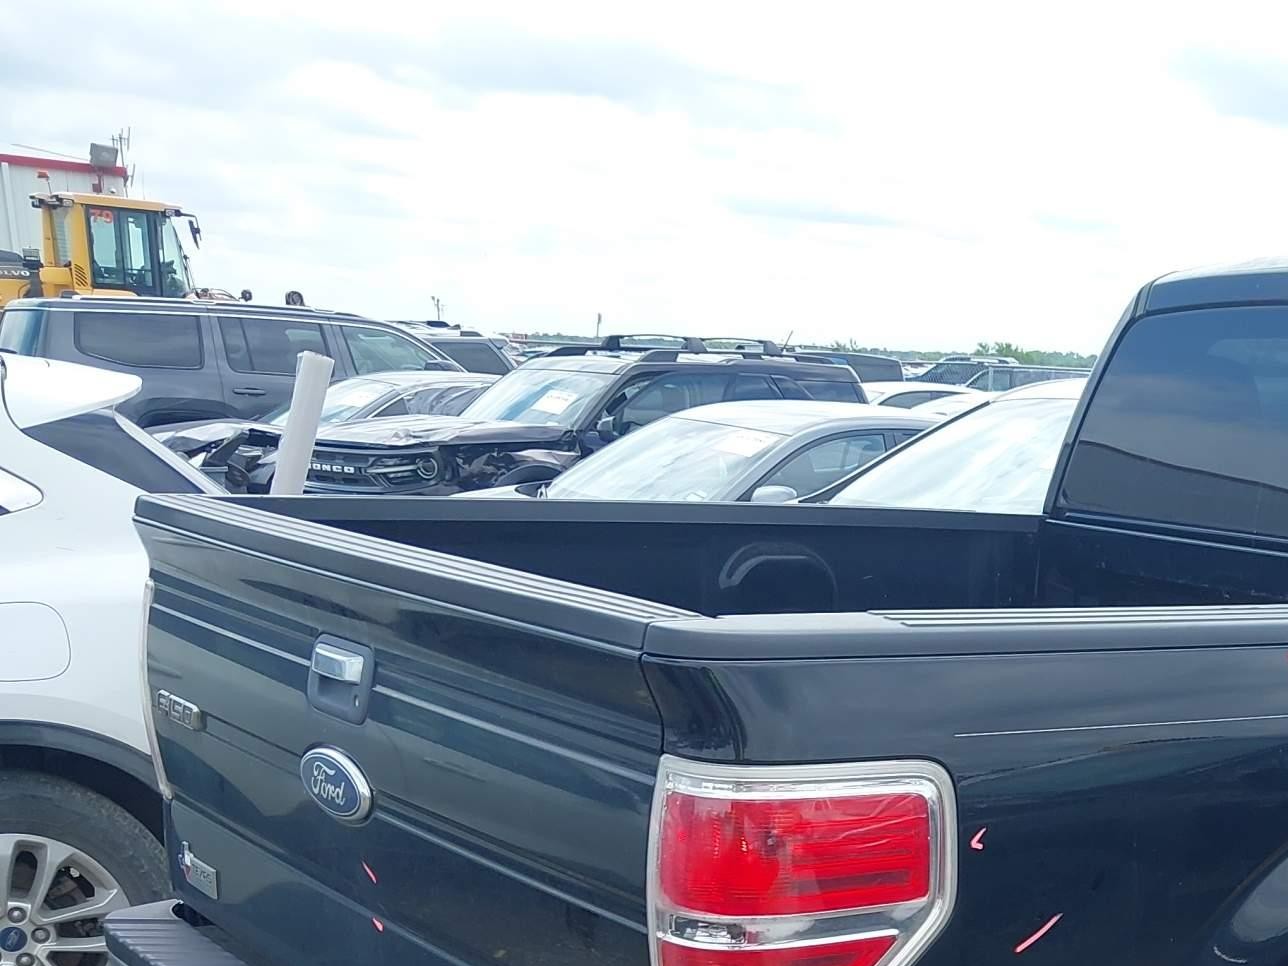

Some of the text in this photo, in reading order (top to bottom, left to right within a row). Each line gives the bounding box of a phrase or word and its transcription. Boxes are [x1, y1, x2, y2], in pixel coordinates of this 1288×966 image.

[90, 208, 114, 224] 79
[309, 463, 355, 474] ONCO
[311, 761, 347, 806] Ford
